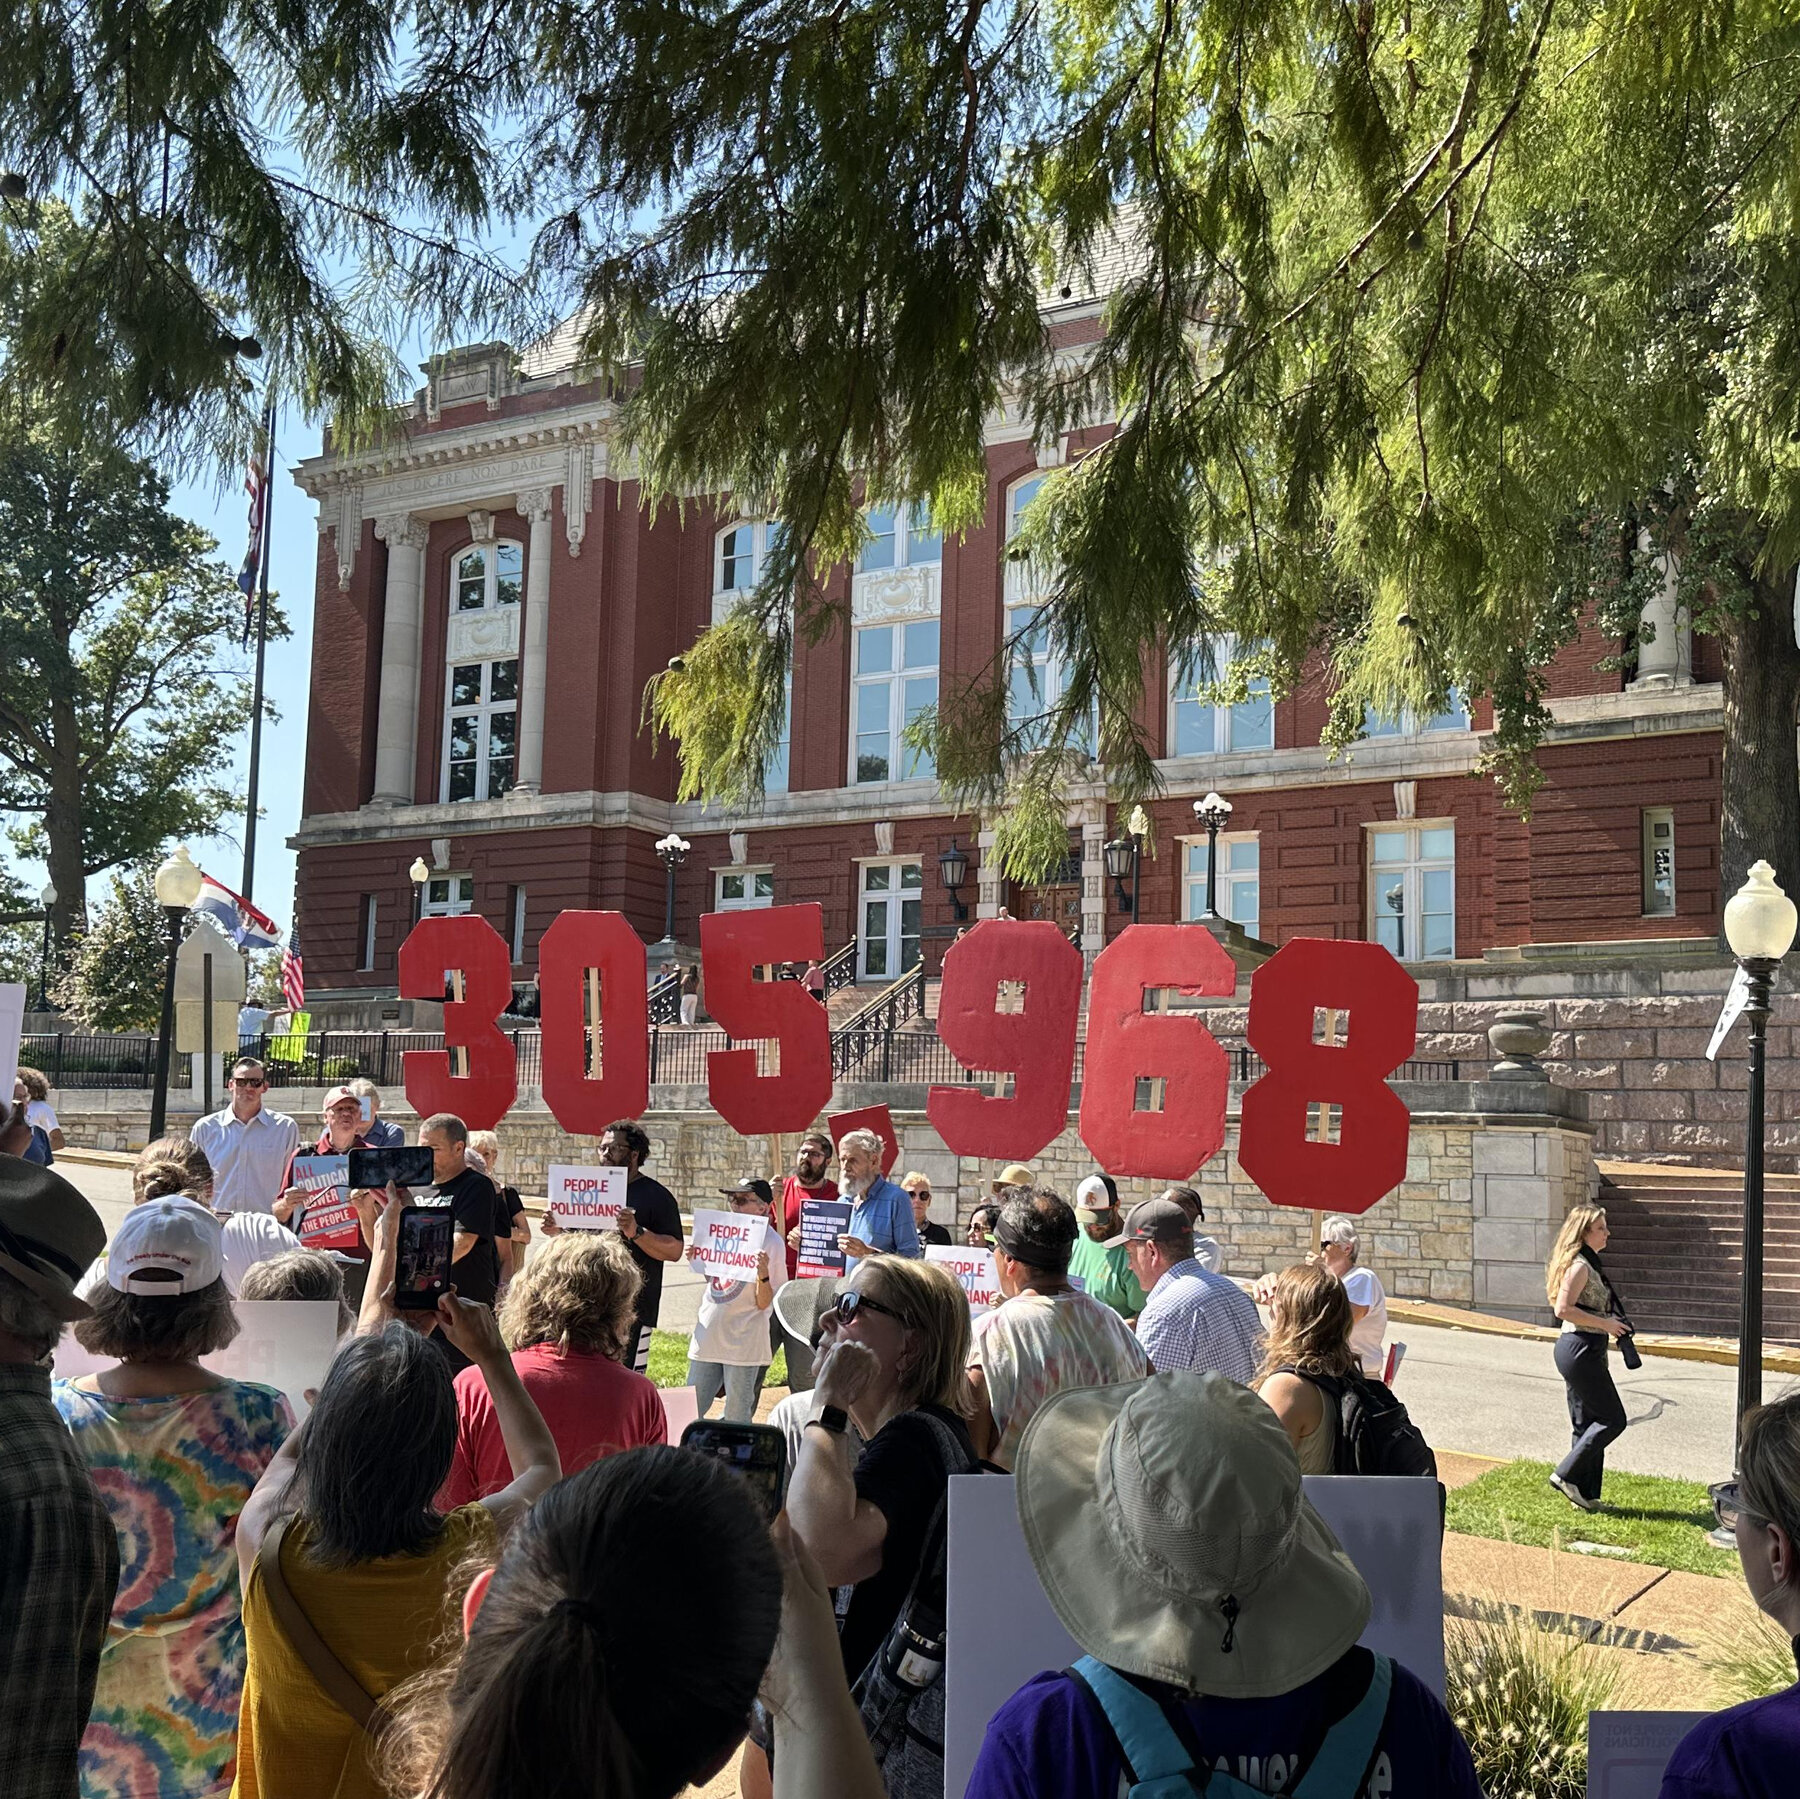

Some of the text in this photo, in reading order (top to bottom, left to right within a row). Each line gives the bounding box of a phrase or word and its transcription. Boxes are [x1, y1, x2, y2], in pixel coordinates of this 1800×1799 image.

[379, 455, 547, 497] JUS DICERE NON DARE
[295, 1164, 315, 1180] ALL
[564, 1178, 609, 1193] PEOPLE
[302, 1188, 339, 1210] POWER
[571, 1188, 600, 1206] NOT
[551, 1202, 622, 1217] POLITICIANS
[302, 1220, 320, 1233] THE
[320, 1209, 350, 1228] PEOPLE
[709, 1223, 750, 1242] PEOPLE
[714, 1237, 743, 1255] NOT
[693, 1247, 757, 1269] POLITICIANS
